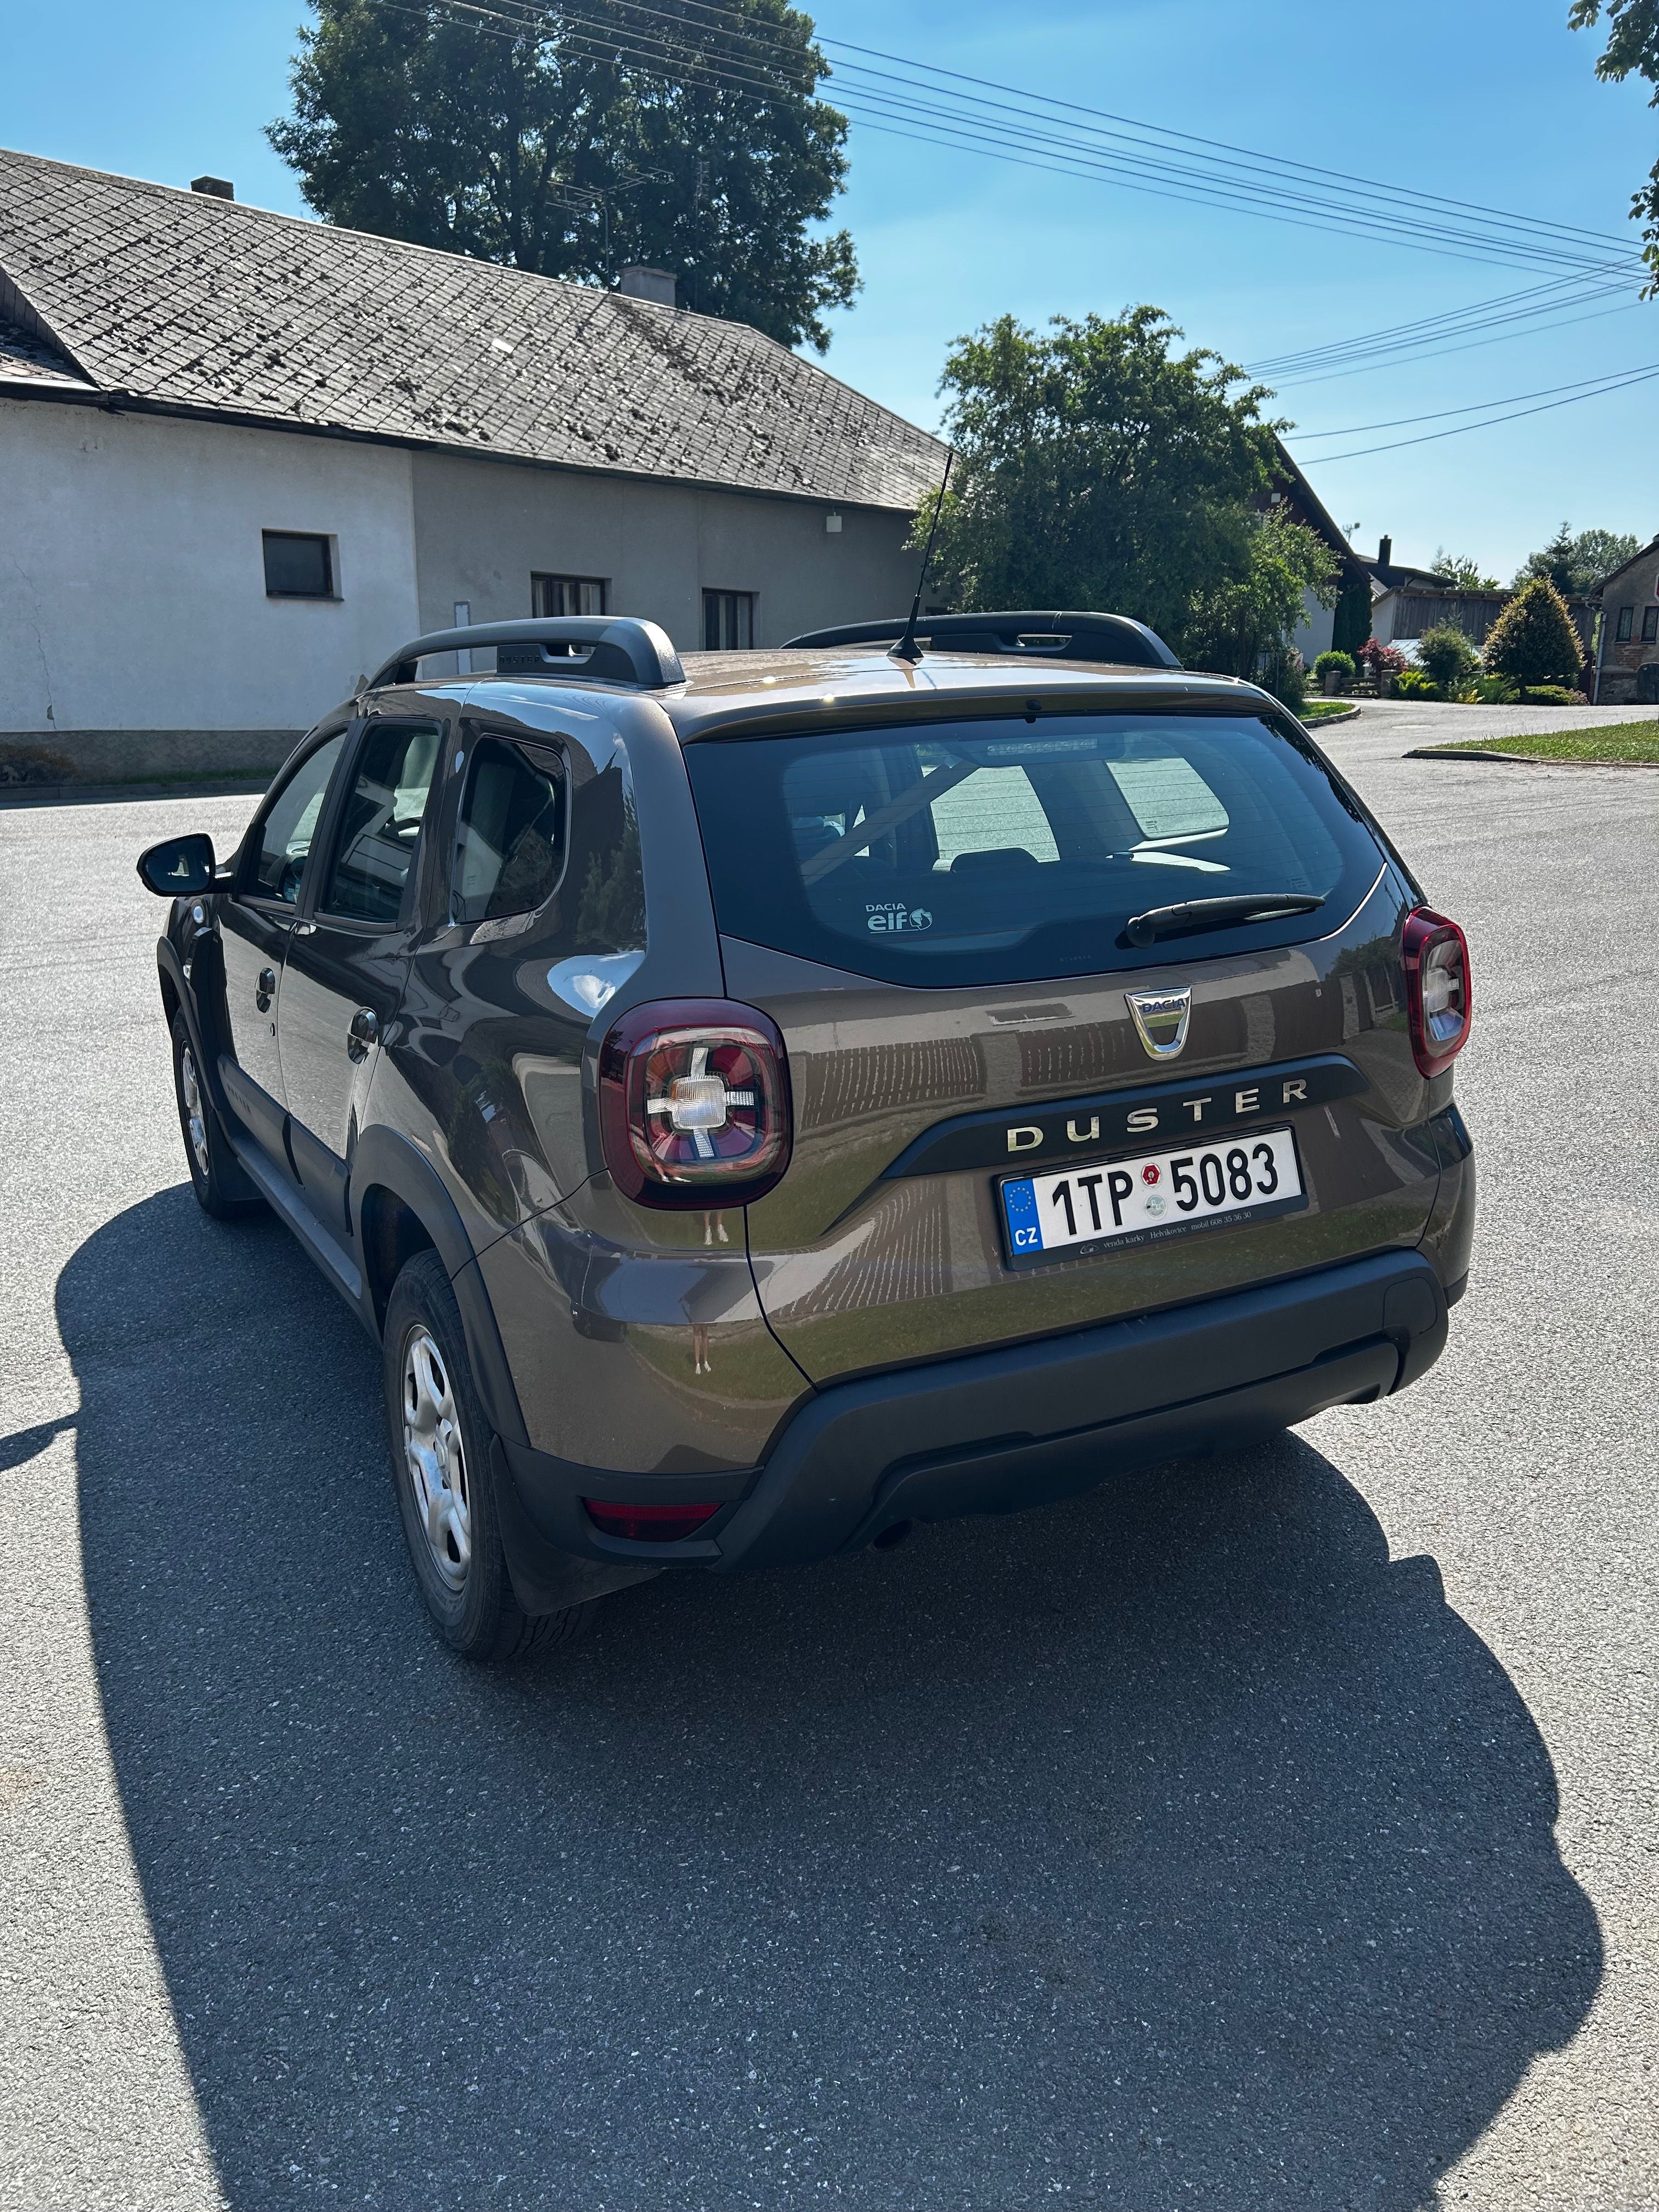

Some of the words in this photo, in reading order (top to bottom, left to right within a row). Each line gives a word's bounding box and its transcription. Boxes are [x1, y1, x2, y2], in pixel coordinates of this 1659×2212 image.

[865, 902, 906, 912] DACIA
[867, 911, 907, 931] elf
[1141, 998, 1186, 1013] DACIA
[1007, 1079, 1308, 1152] DUSTER
[1052, 1170, 1133, 1235] 1TP
[1170, 1143, 1278, 1212] 5083
[1191, 1220, 1210, 1230] mobil
[1210, 1217, 1223, 1226] 608
[1224, 1215, 1232, 1223] 35
[1233, 1213, 1242, 1221] 36
[1015, 1227, 1038, 1246] CZ
